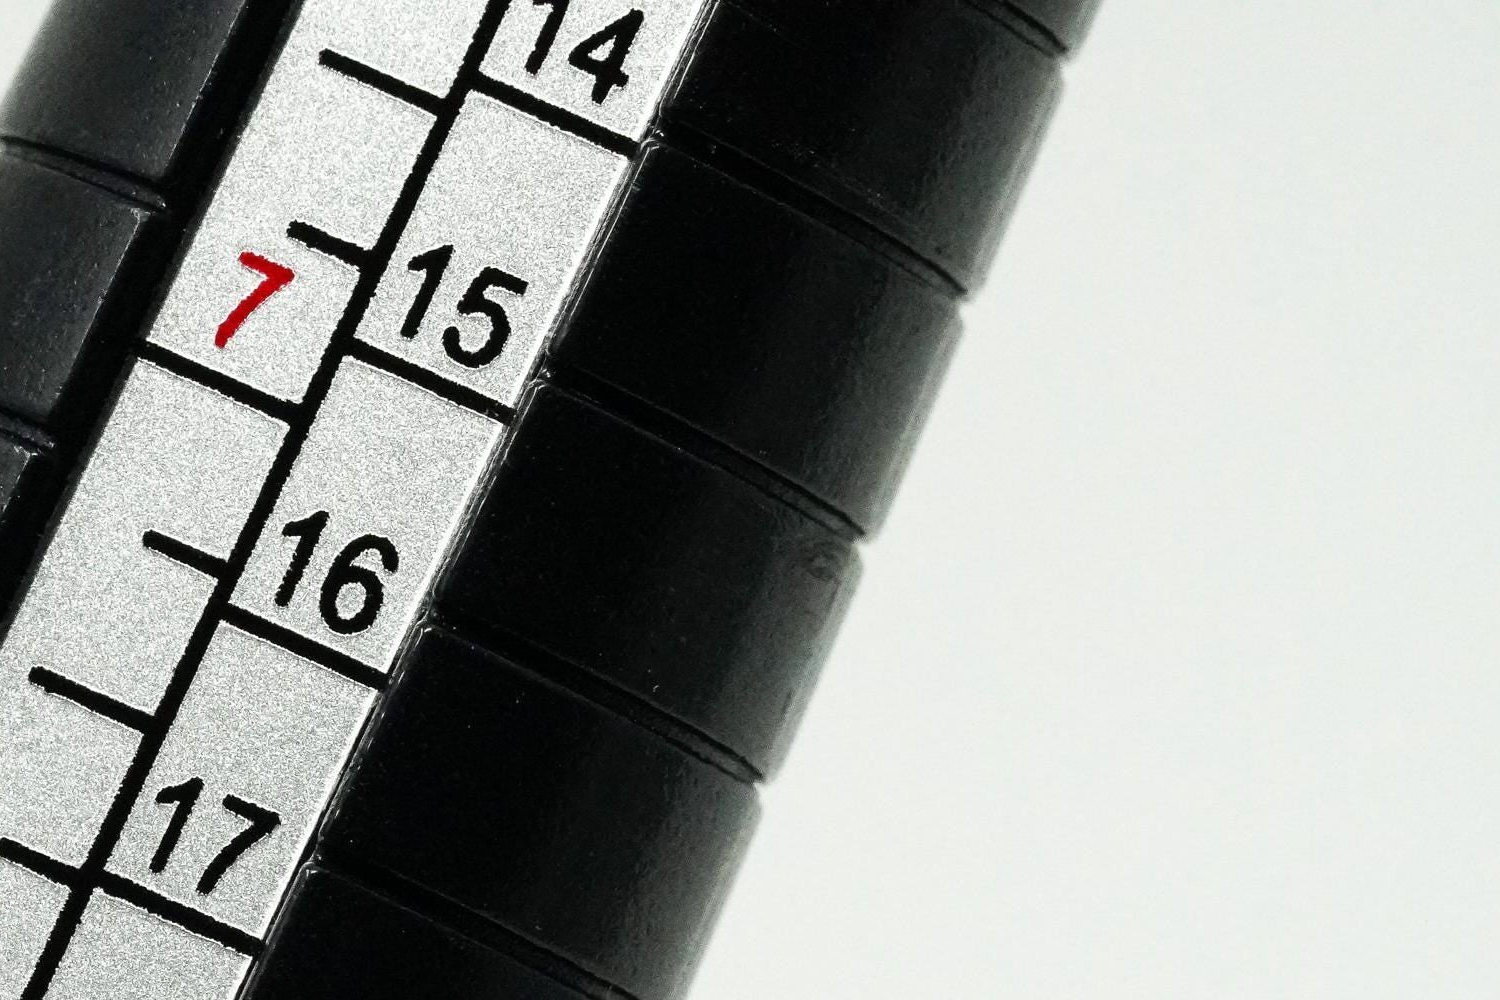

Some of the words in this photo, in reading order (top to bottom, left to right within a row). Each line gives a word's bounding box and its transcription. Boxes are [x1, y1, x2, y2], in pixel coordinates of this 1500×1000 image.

[526, 0, 645, 104] 14
[214, 251, 295, 348] 7
[400, 244, 529, 370] 15
[275, 510, 400, 636] 16
[151, 776, 281, 895] 17
